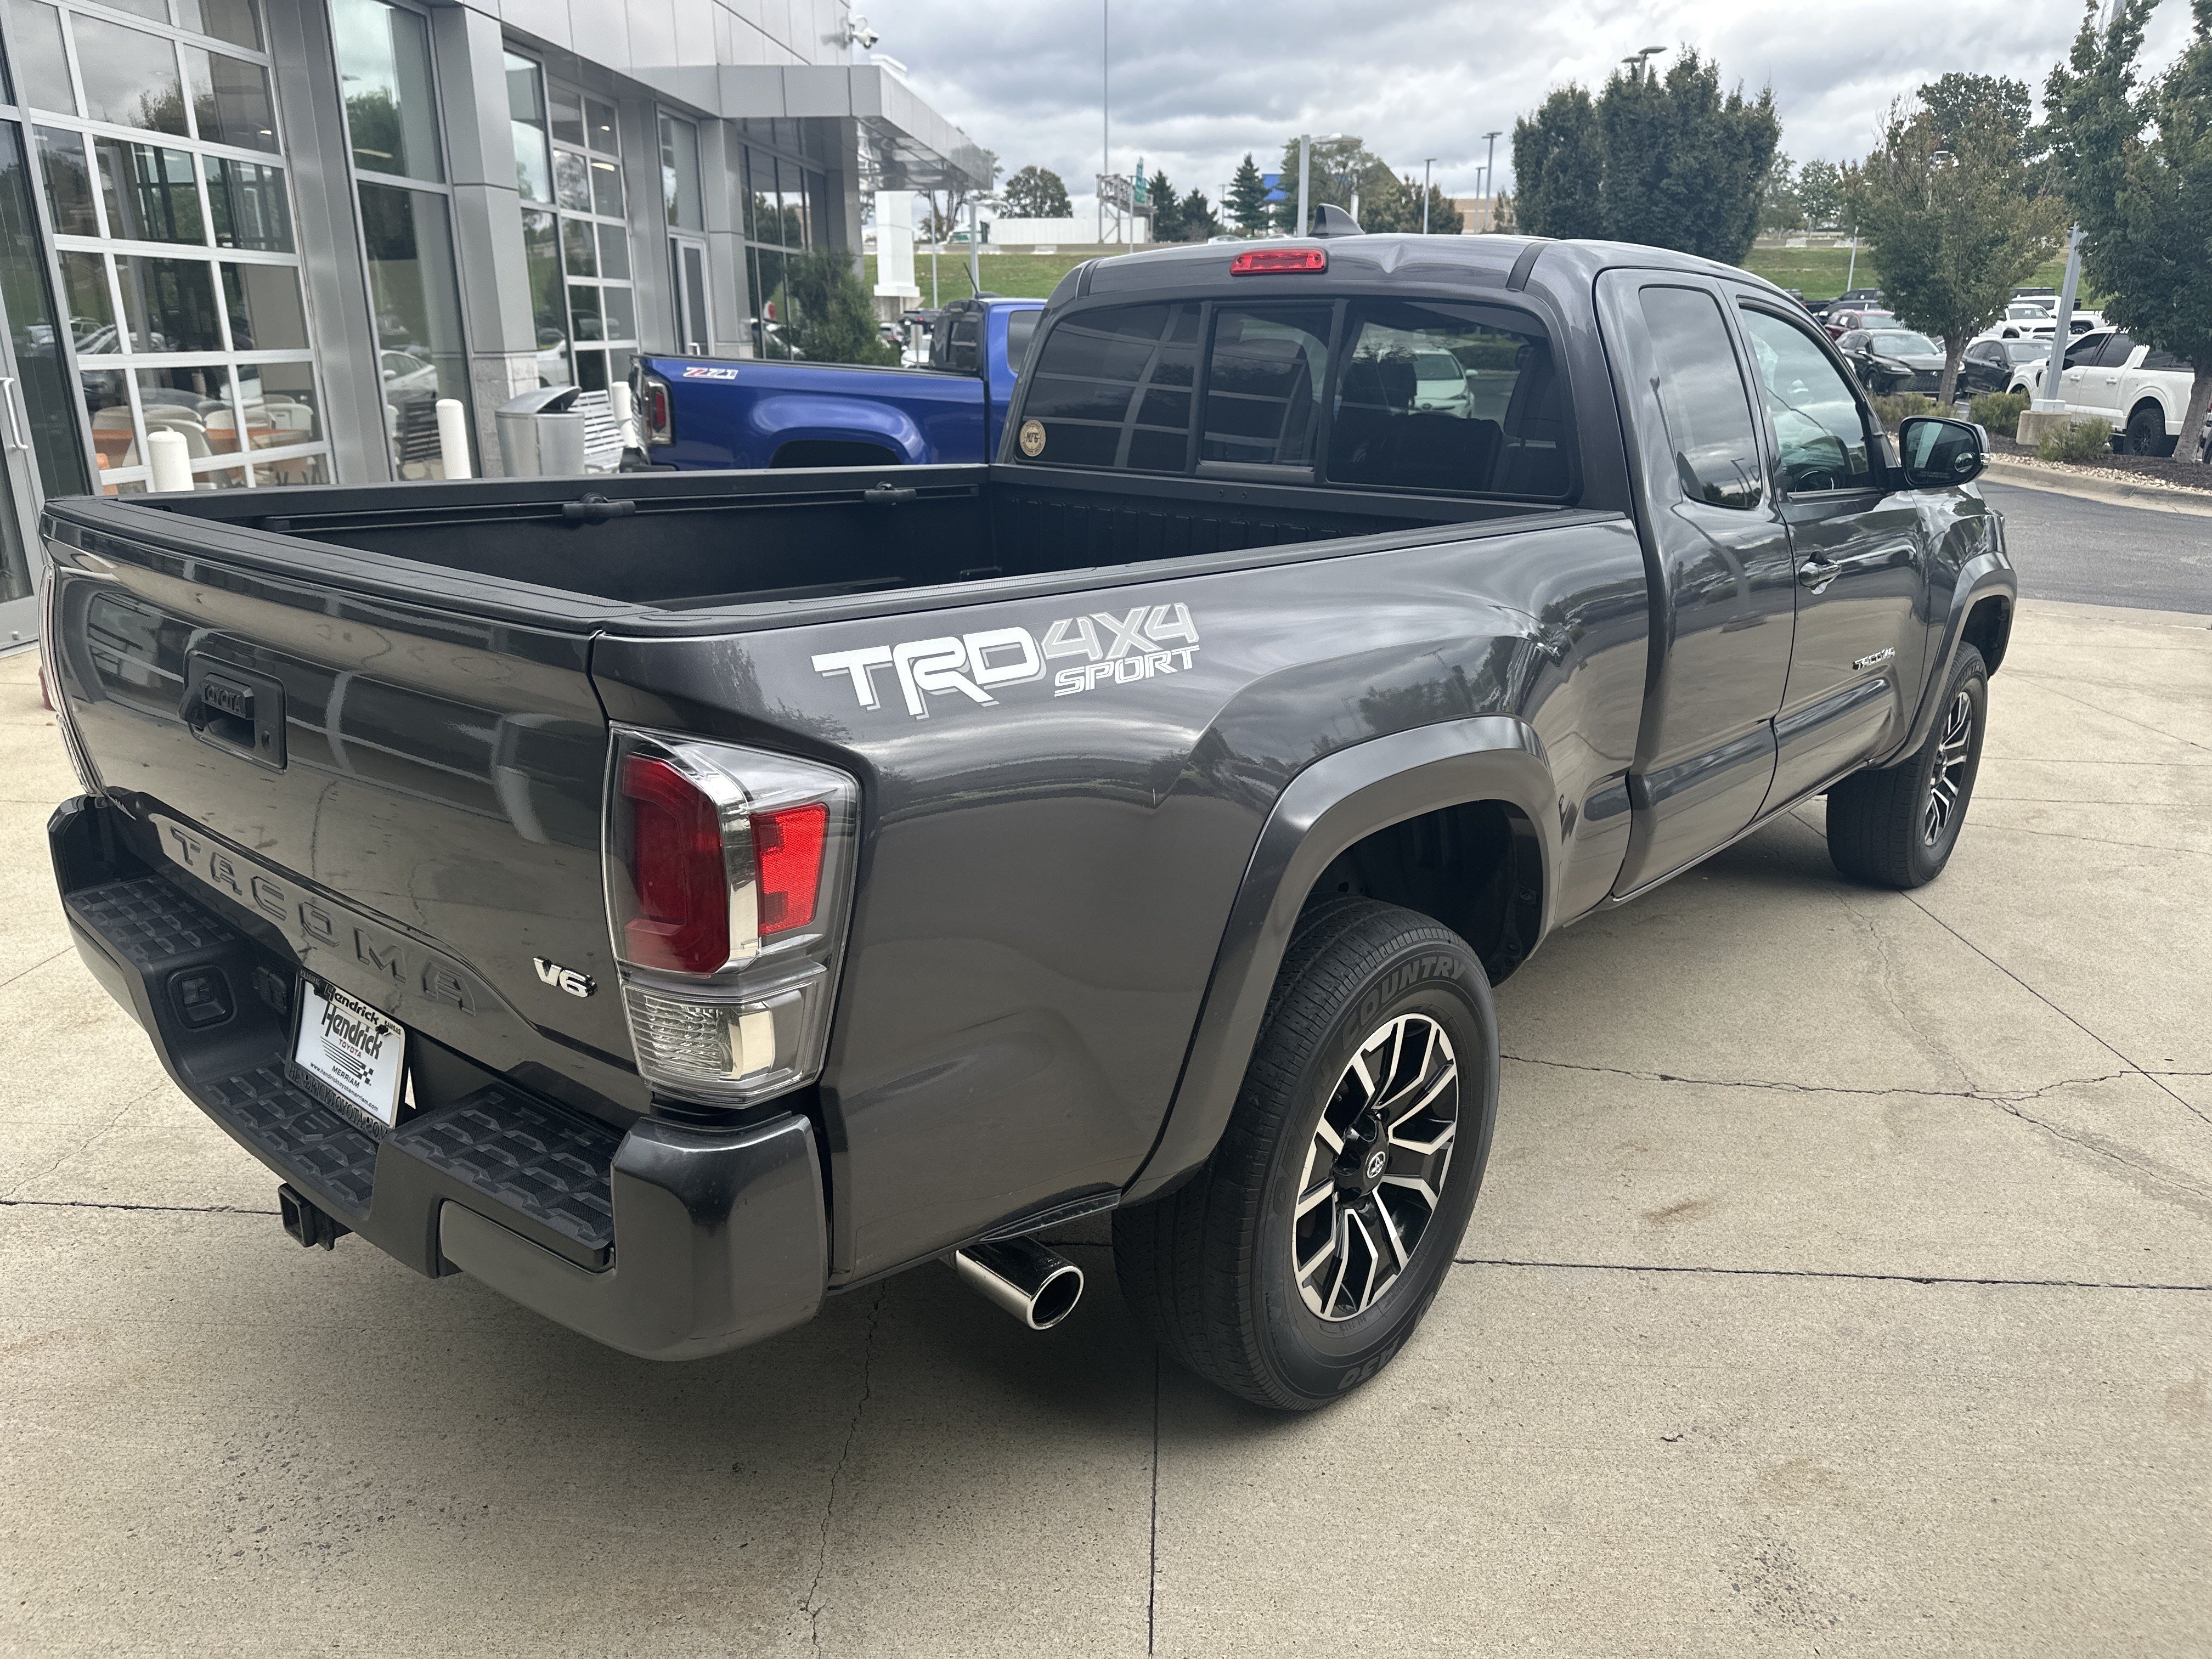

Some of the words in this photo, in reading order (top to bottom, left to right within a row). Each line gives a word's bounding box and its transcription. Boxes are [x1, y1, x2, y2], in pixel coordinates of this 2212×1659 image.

[683, 366, 738, 380] Z71
[811, 626, 1046, 720] TRD
[1042, 602, 1200, 661] 4X4
[1054, 645, 1200, 697] SPORT
[200, 682, 246, 714] TOYOTA
[169, 825, 477, 1017] TACOMA
[533, 956, 598, 998] V6
[325, 983, 380, 1025] Hendrick
[1342, 956, 1466, 1050] COUNTRY
[321, 1001, 383, 1060] Hendrick
[384, 1019, 401, 1036] KANSAS
[338, 1039, 362, 1059] TOYOTA
[331, 1065, 360, 1089] MERRIAM
